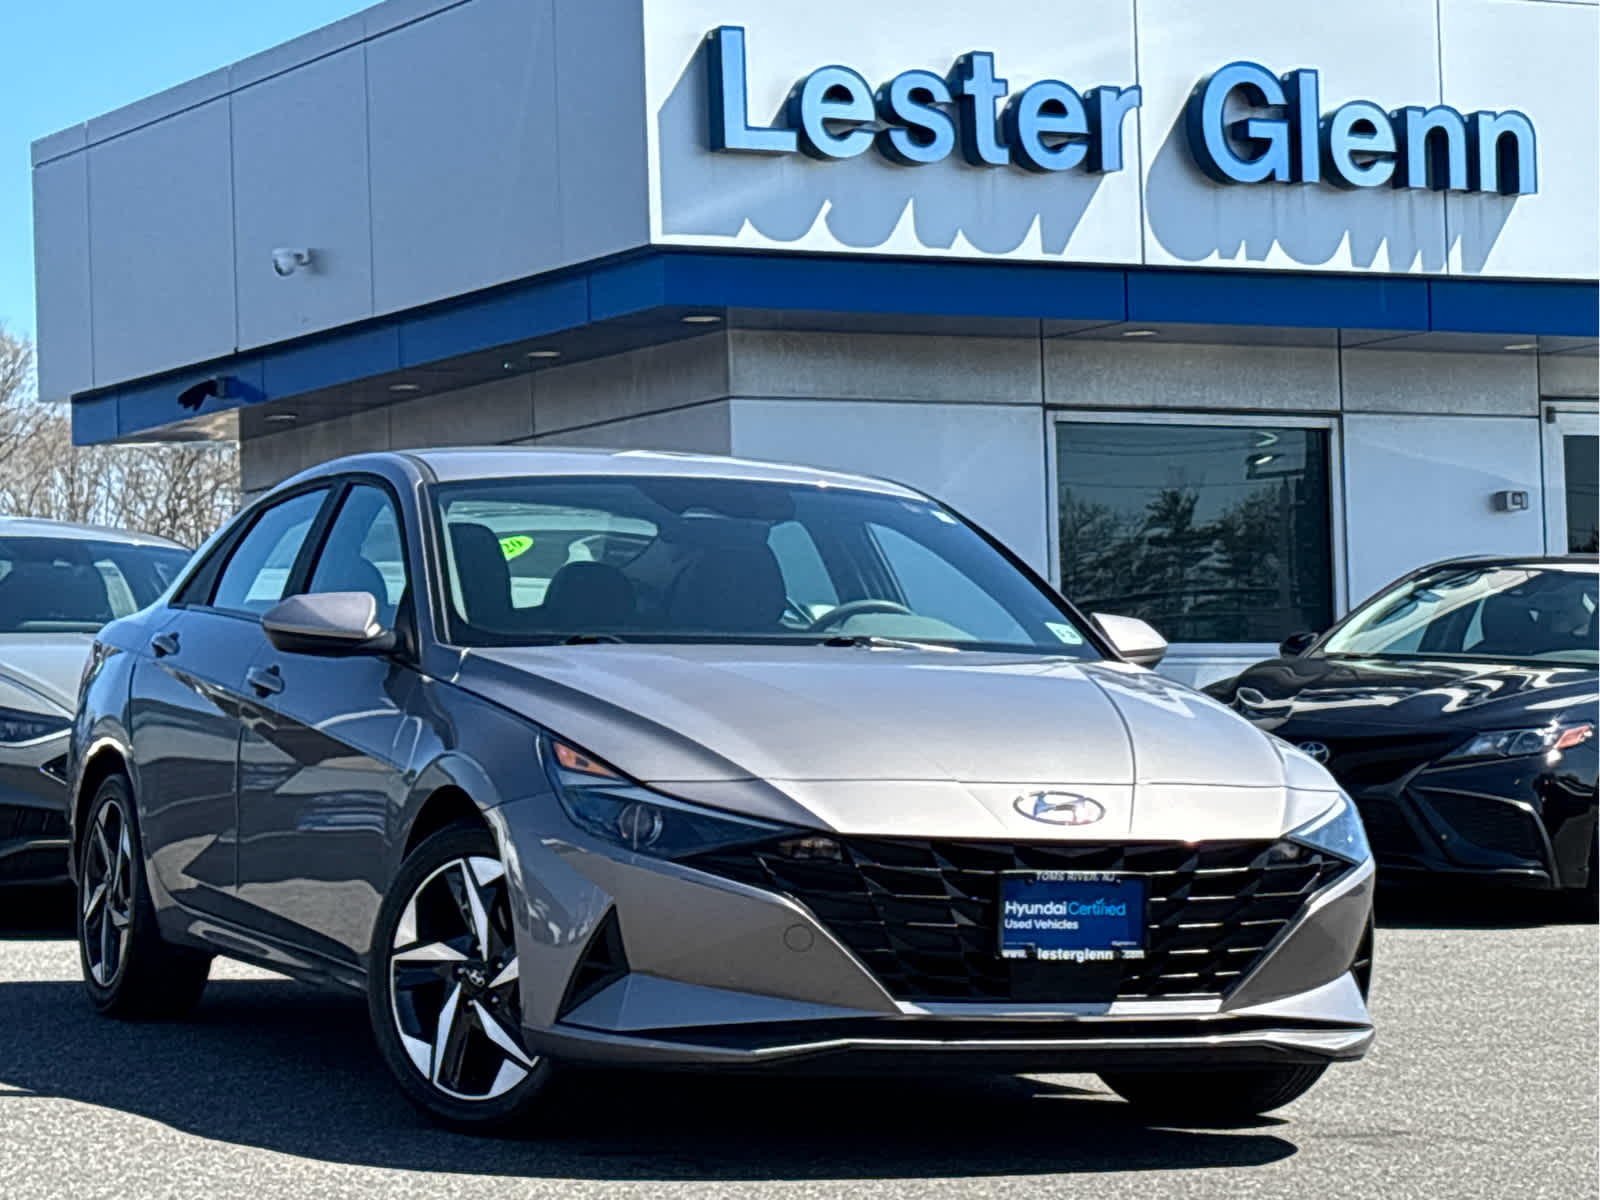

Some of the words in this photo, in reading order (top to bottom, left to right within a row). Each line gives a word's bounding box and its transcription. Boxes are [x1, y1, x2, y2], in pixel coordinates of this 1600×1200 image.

[706, 25, 1142, 173] Lester
[1186, 60, 1539, 196] Glenn
[1004, 901, 1067, 918] Hyundai
[1004, 919, 1033, 929] Used
[1034, 919, 1080, 930] Vehicles
[1037, 947, 1114, 963] lesterglenn
